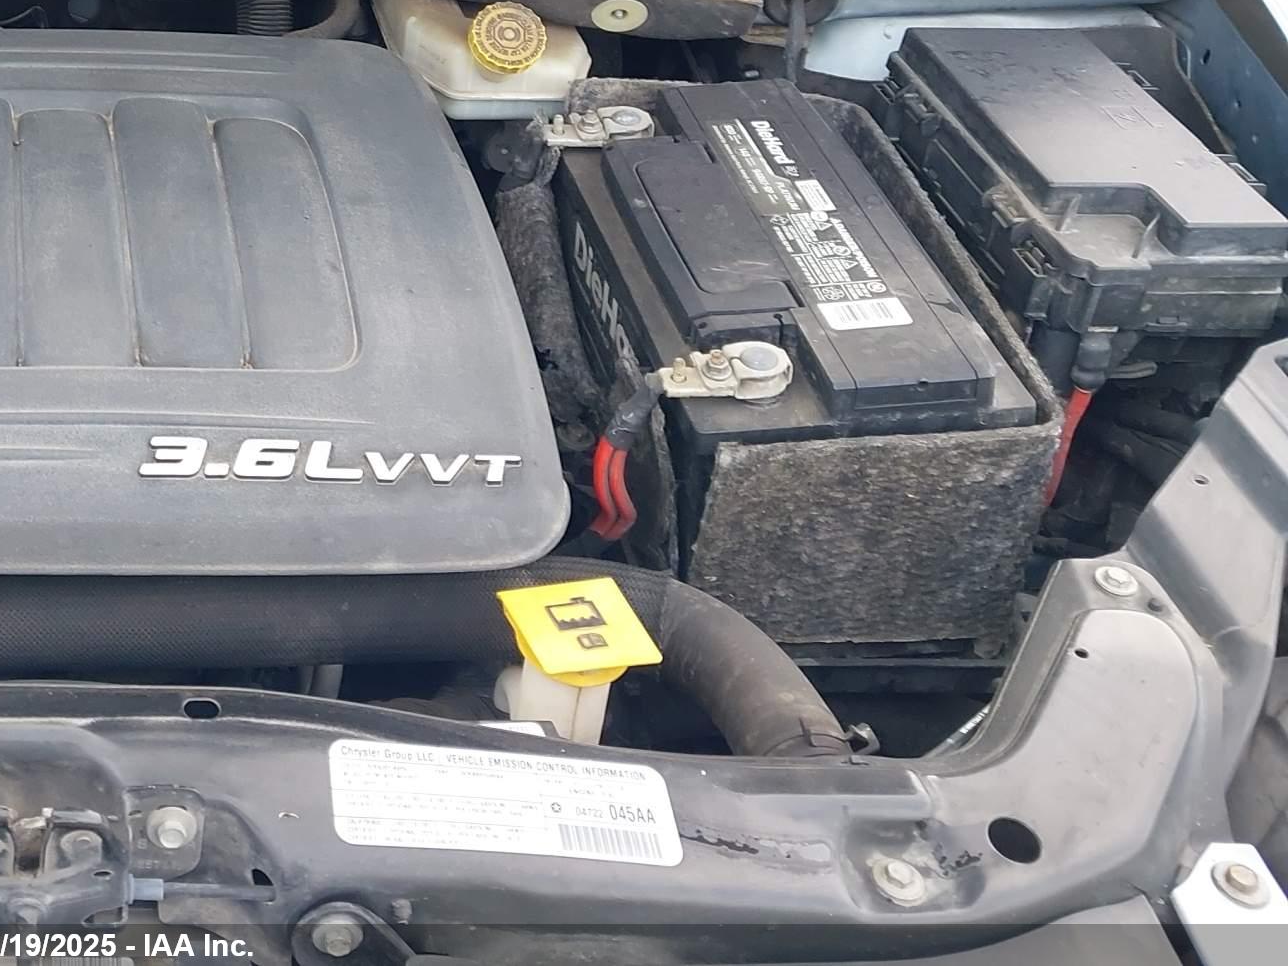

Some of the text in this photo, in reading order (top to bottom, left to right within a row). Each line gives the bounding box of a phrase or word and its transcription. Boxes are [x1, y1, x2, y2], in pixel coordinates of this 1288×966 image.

[751, 121, 796, 165] DieHard
[341, 745, 434, 762] Chrysler Group LLC
[446, 754, 646, 781] VEHICLE EMISSION CONTROL INFORMATION
[608, 803, 656, 824] 045AA
